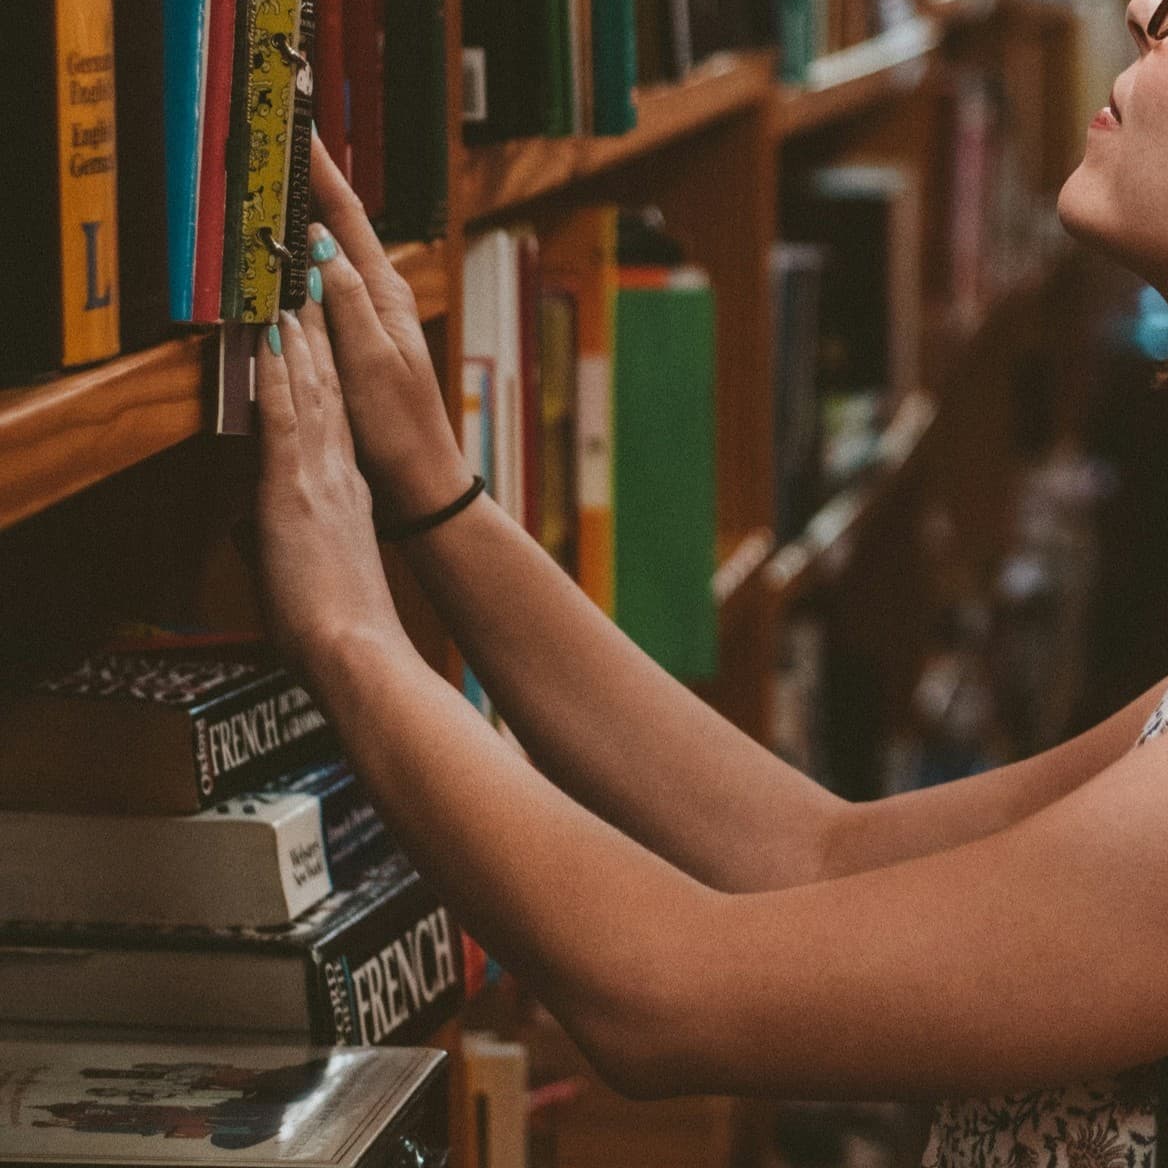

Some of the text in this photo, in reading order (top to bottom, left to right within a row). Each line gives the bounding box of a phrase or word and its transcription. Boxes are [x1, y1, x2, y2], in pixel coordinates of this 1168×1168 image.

[81, 221, 110, 310] L
[208, 698, 281, 776] FRENCH
[352, 907, 455, 1047] FRENCH
